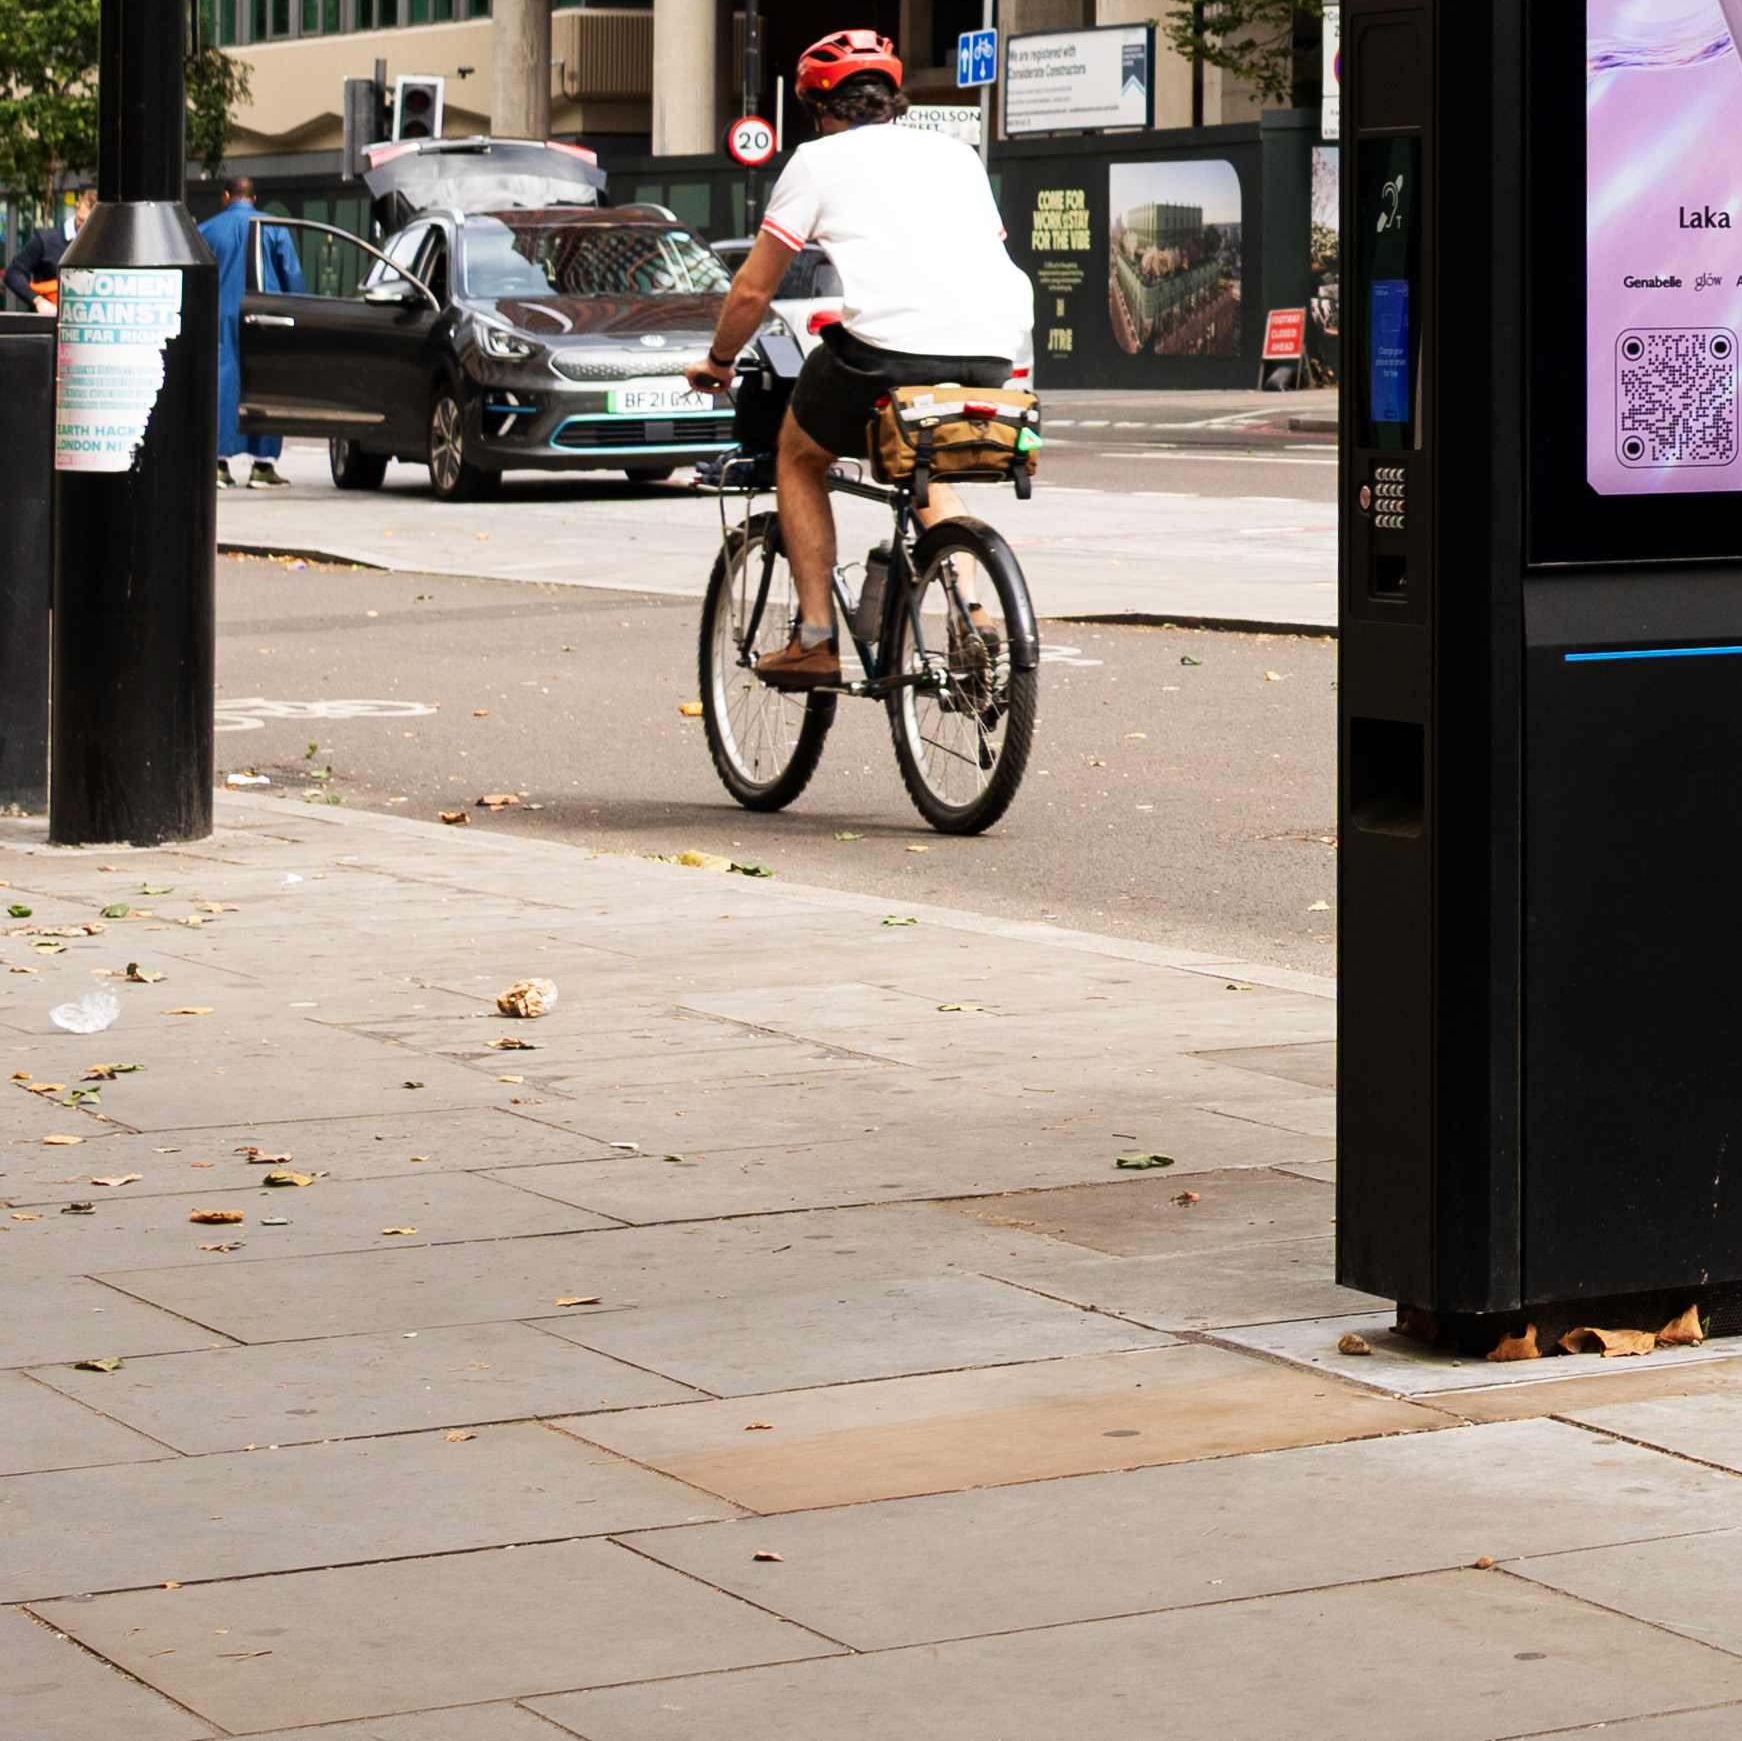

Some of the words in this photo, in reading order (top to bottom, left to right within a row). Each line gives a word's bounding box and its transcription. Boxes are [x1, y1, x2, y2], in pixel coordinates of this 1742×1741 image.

[1031, 46, 1062, 64] registered
[1063, 44, 1077, 57] with
[1046, 63, 1087, 78] Constructors
[899, 110, 981, 122] ICHOLSON
[738, 130, 769, 151] 20
[1038, 189, 1064, 211] COME
[1066, 189, 1085, 211] FOR
[1033, 210, 1062, 231] WORK
[1068, 210, 1090, 231] STAY
[1680, 206, 1731, 228] Laka
[1032, 229, 1050, 251] FOR
[1052, 229, 1070, 250] THE
[1071, 229, 1091, 251] VIBE
[62, 274, 174, 297] WOMEN
[1624, 276, 1682, 288] Genabelle
[62, 301, 172, 325] AGAINST
[60, 328, 80, 343] THE
[84, 328, 114, 343] FAR
[1271, 328, 1297, 339] CLOSED
[1271, 341, 1295, 351] AHEAD
[57, 440, 102, 452] LONDON
